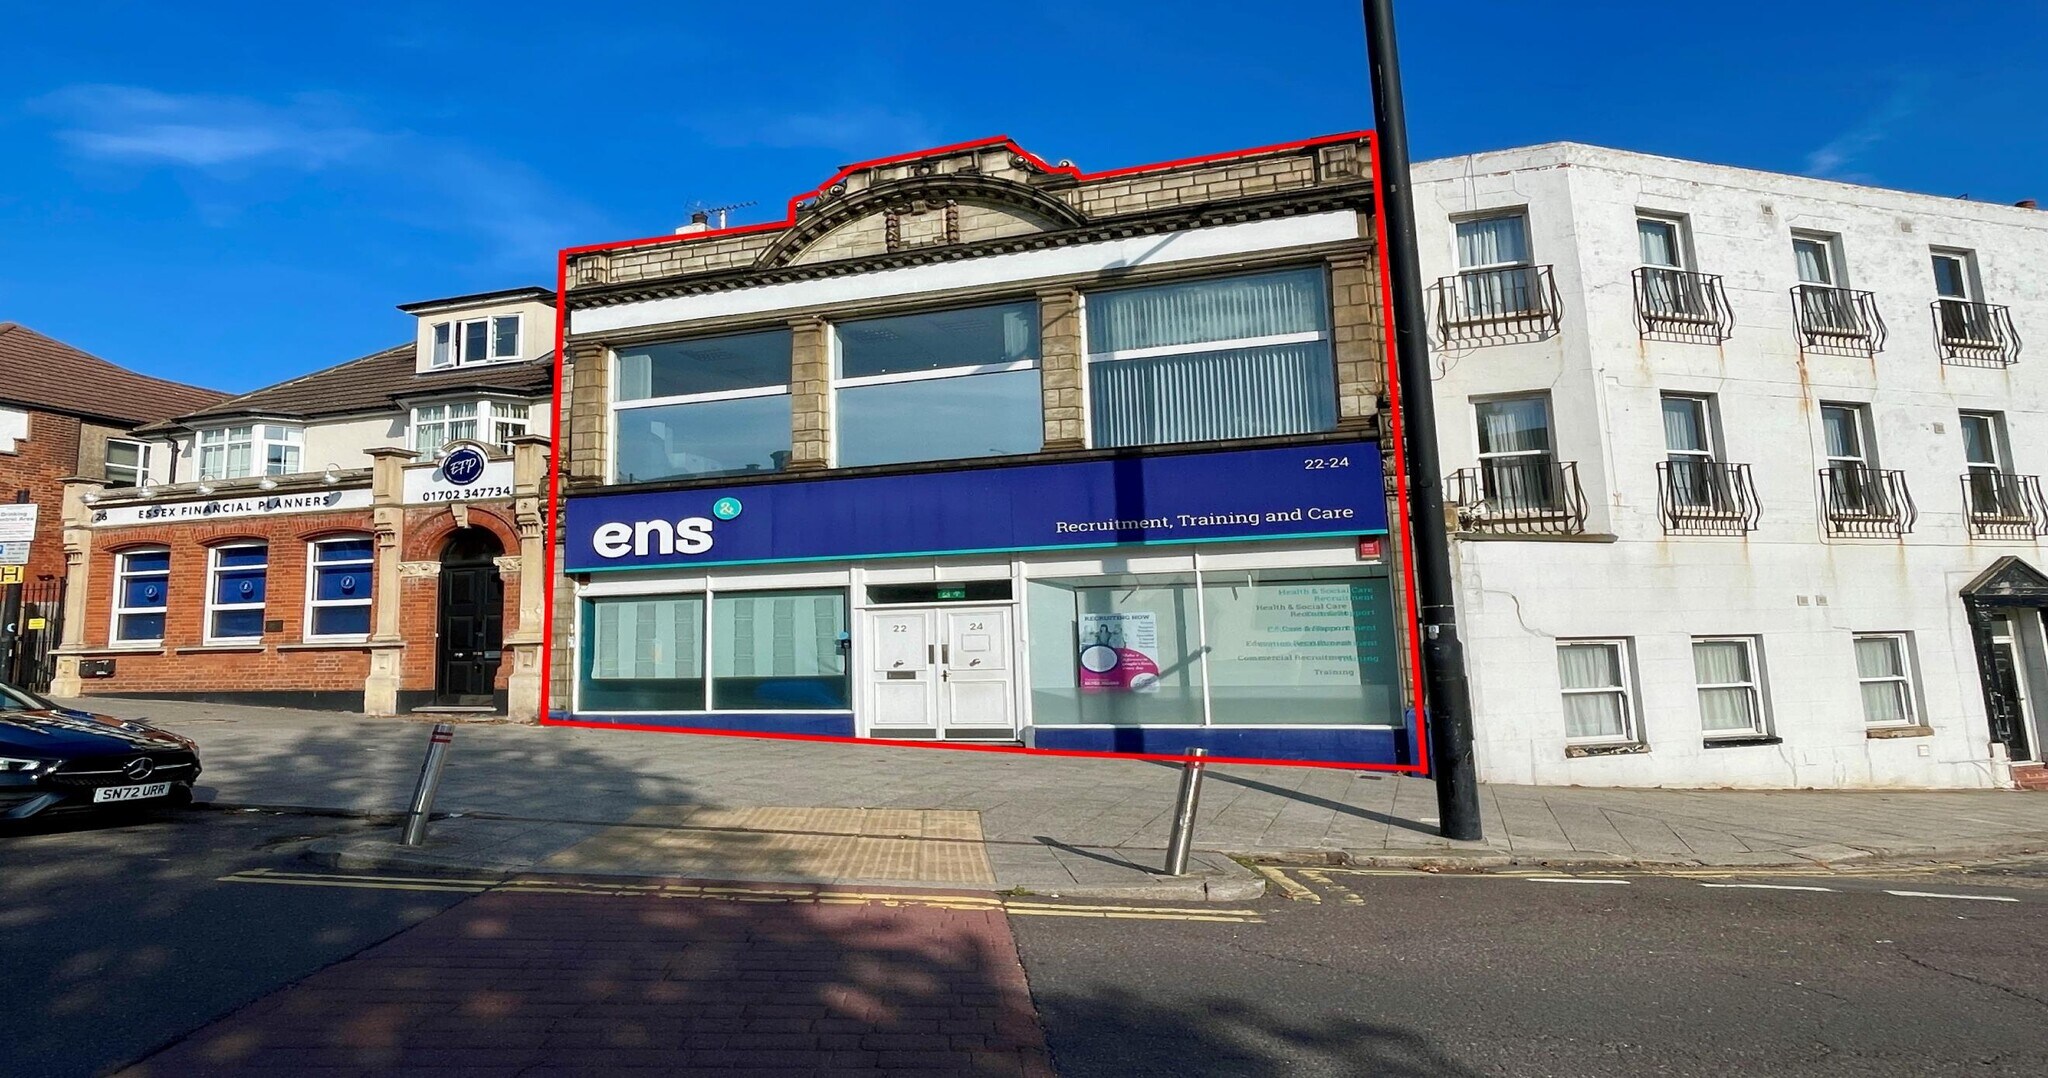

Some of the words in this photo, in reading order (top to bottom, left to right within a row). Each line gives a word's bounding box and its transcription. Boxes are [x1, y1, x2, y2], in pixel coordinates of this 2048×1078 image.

[449, 457, 477, 476] EFP
[1304, 456, 1350, 470] 22-24
[423, 490, 460, 501] 01702
[464, 486, 510, 499] 347734
[138, 507, 177, 519] ESSEX
[181, 502, 252, 516] FINANCIAL
[258, 496, 330, 511] PLANNERS
[95, 512, 108, 521] 26
[1055, 517, 1174, 534] Recruitment,
[1177, 511, 1260, 528] Training
[1265, 508, 1302, 523] and
[1307, 507, 1354, 521] Care
[592, 517, 714, 558] ens
[892, 624, 907, 633] 22
[969, 622, 984, 631] 24
[102, 786, 140, 800] SN72
[142, 784, 165, 797] URR
